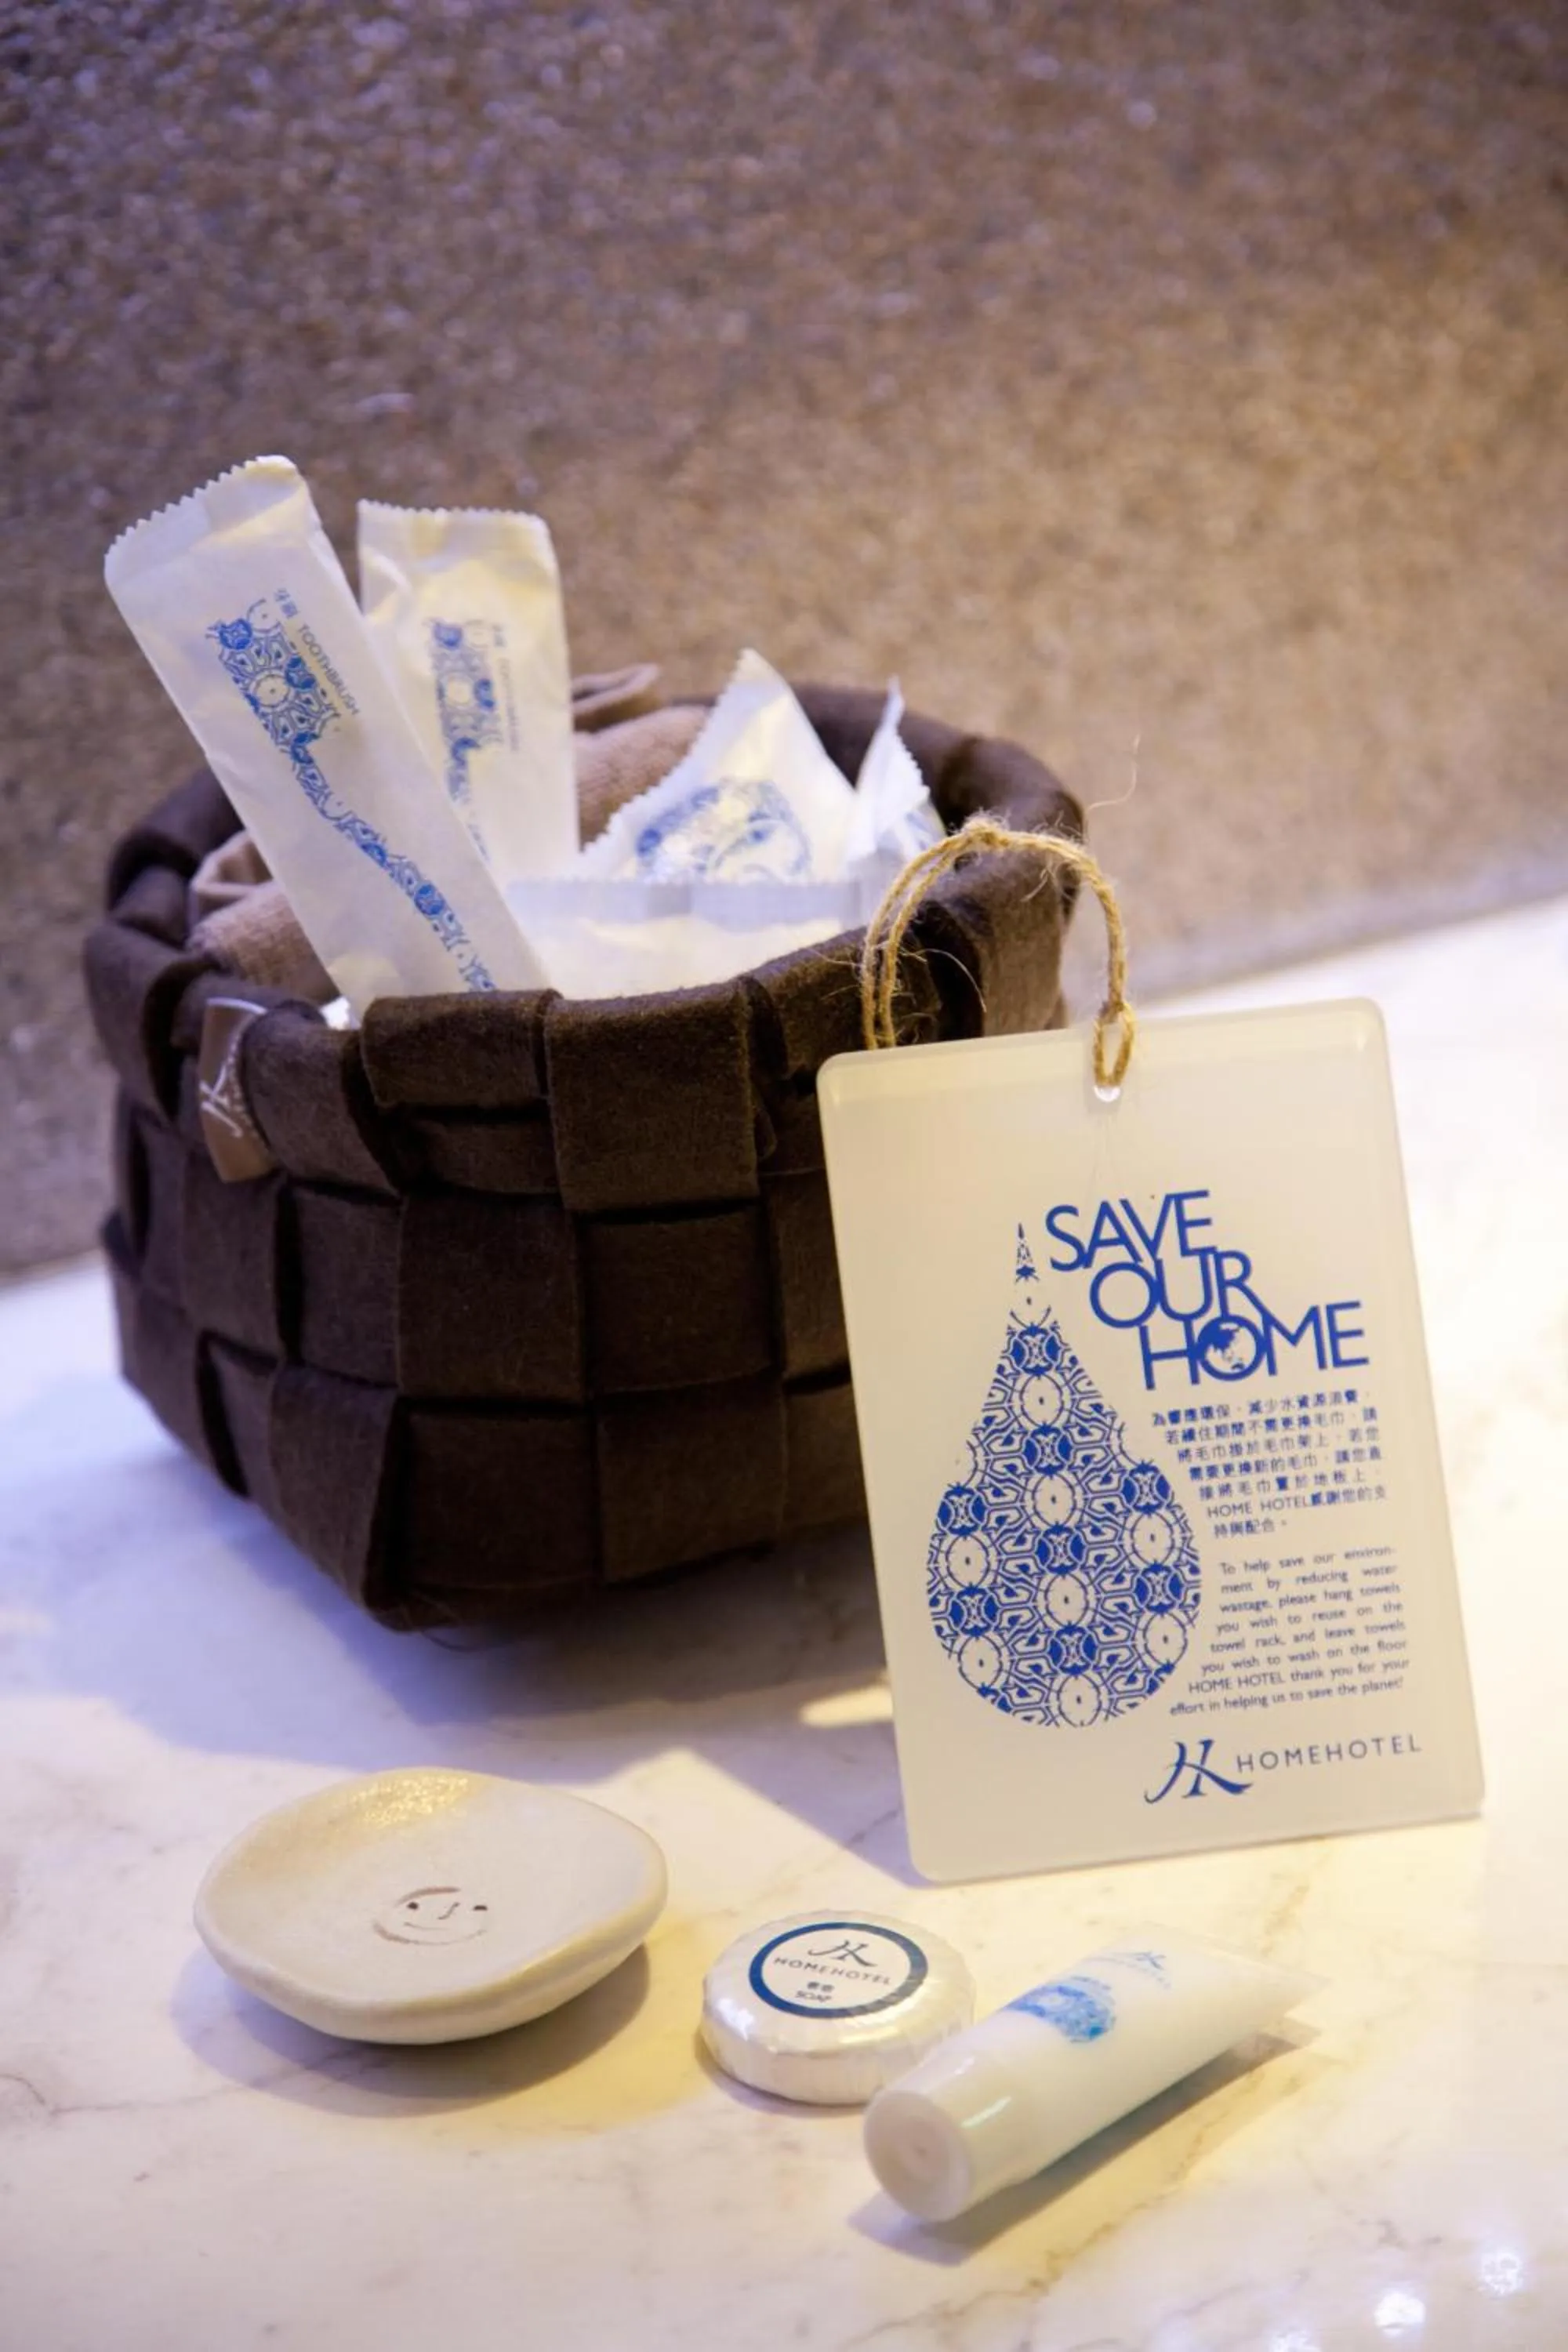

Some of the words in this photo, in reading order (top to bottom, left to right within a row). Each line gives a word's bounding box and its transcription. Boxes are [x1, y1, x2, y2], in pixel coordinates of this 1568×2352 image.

[296, 623, 360, 715] TOOTHBRUSH
[1044, 1189, 1217, 1272] SAVE
[1090, 1250, 1264, 1329] OUR
[1138, 1301, 1369, 1390] HOME
[1207, 1501, 1253, 1519] HOME
[1220, 1563, 1236, 1574] To
[1244, 1560, 1272, 1573] help
[1279, 1556, 1305, 1568] save
[1313, 1553, 1336, 1564] our
[1221, 1582, 1253, 1594] ment
[1267, 1577, 1280, 1591] by
[1296, 1571, 1348, 1584] reducing
[1279, 1594, 1316, 1606] please
[1324, 1588, 1352, 1602] hang
[1360, 1584, 1400, 1596] towels
[1217, 1622, 1240, 1636] you
[1250, 1616, 1277, 1628] wish
[1288, 1613, 1301, 1624] to
[1312, 1609, 1346, 1620] reuse
[1357, 1606, 1373, 1615] on
[1384, 1602, 1403, 1613] the
[1210, 1639, 1246, 1652] towel
[1294, 1632, 1316, 1642] and
[1324, 1627, 1356, 1639] leave
[1365, 1621, 1406, 1632] towels
[1201, 1663, 1225, 1676] you
[1232, 1657, 1259, 1670] wish
[1268, 1654, 1280, 1665] to
[1289, 1651, 1319, 1662] wash
[1327, 1647, 1343, 1657] on
[1351, 1643, 1370, 1654] the
[1377, 1639, 1406, 1651] floor
[1189, 1678, 1232, 1693] HOME
[1238, 1672, 1285, 1686] HOTEL
[1290, 1668, 1323, 1681] thank
[1330, 1666, 1353, 1679] you
[1358, 1662, 1374, 1672] for
[1382, 1658, 1409, 1671] your
[1171, 1702, 1205, 1715] effort
[1210, 1700, 1220, 1711] in
[1224, 1694, 1268, 1709] helping
[1272, 1693, 1286, 1703] us
[1290, 1690, 1303, 1700] to
[1308, 1687, 1334, 1699] save
[1338, 1683, 1357, 1694] the
[1236, 1733, 1422, 1773] HOMEHOTEL
[773, 1957, 892, 1986] HOMEHOTEL
[794, 1989, 833, 2002] SOAP
